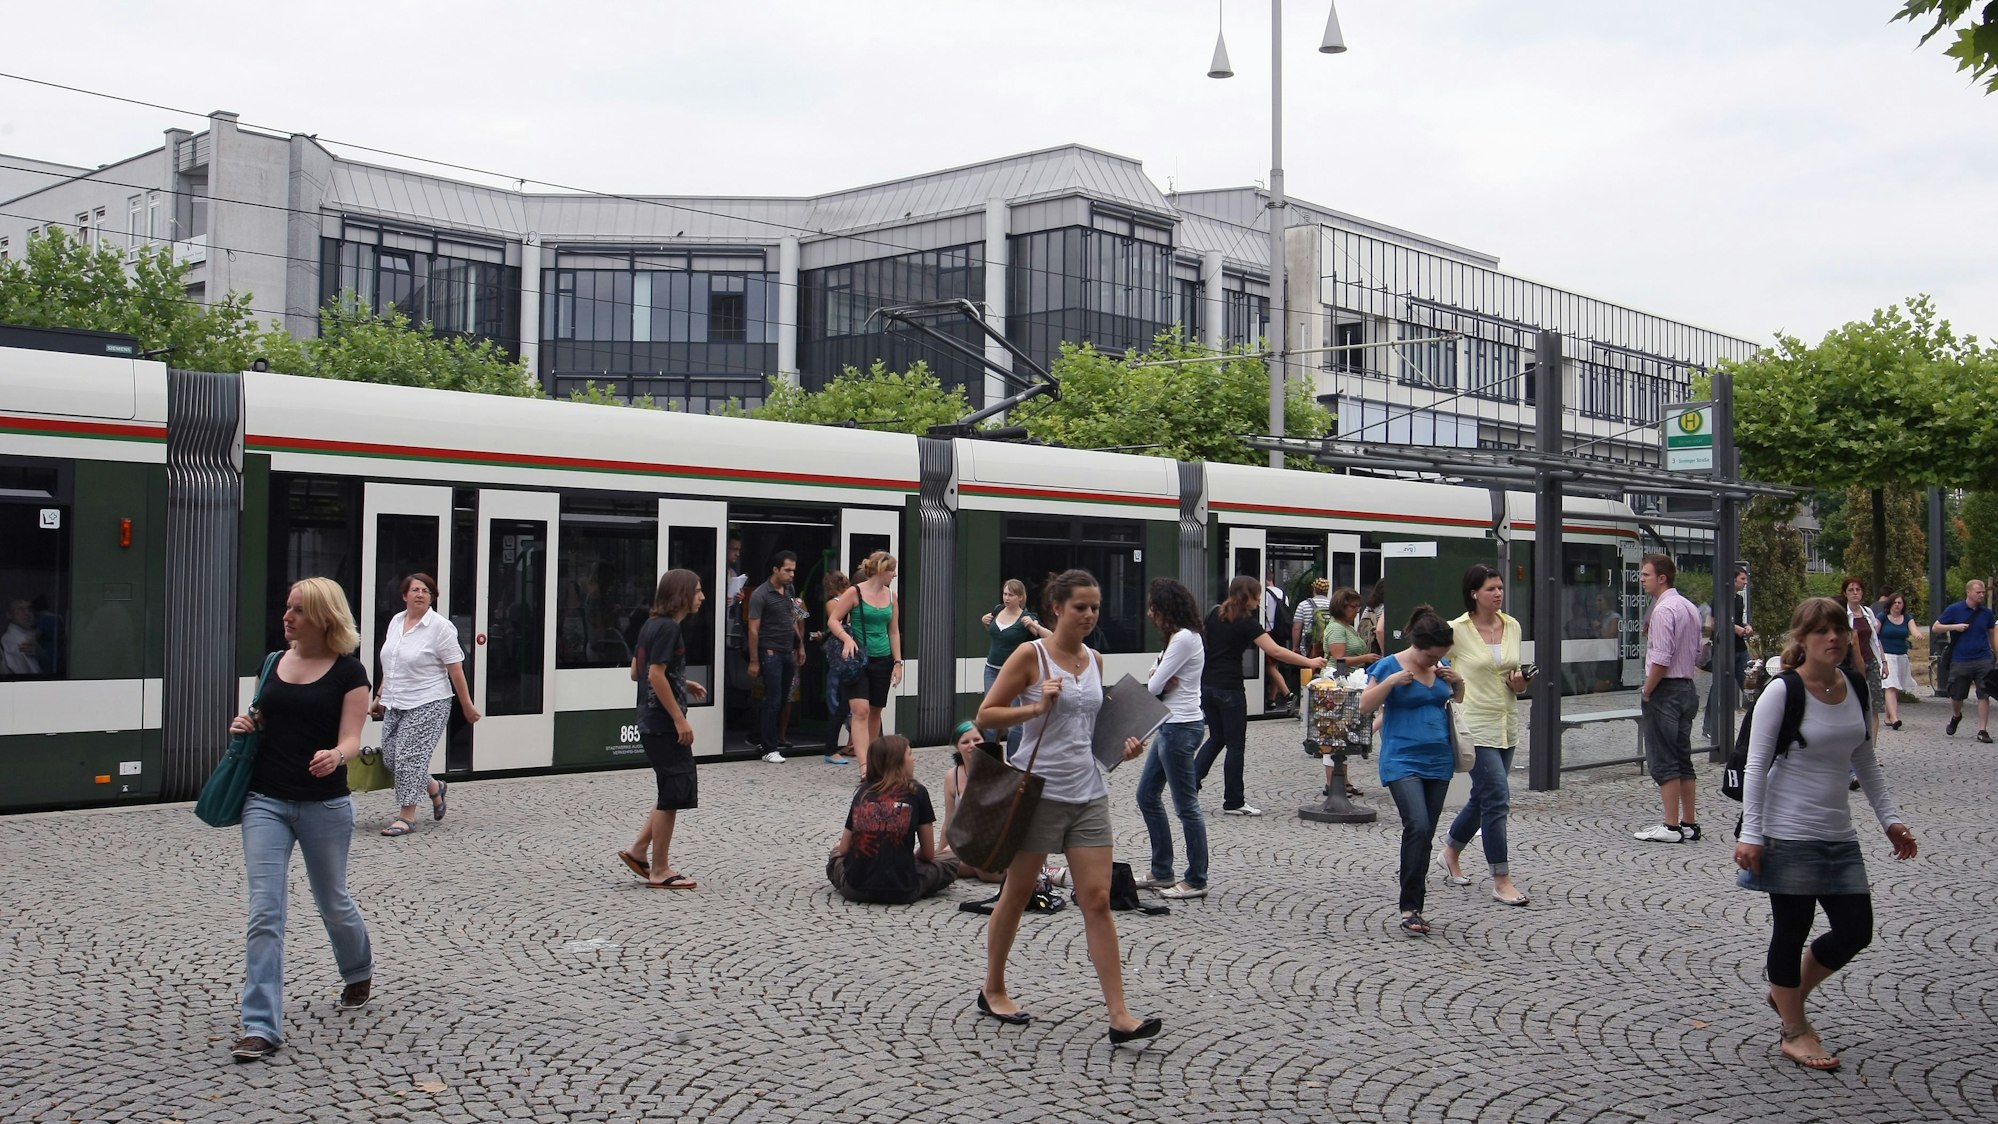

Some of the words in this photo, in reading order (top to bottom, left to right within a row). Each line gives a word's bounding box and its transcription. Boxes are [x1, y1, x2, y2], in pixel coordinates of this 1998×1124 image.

[107, 345, 132, 353] SIEMENS
[1684, 413, 1696, 428] H
[621, 725, 641, 743] 865
